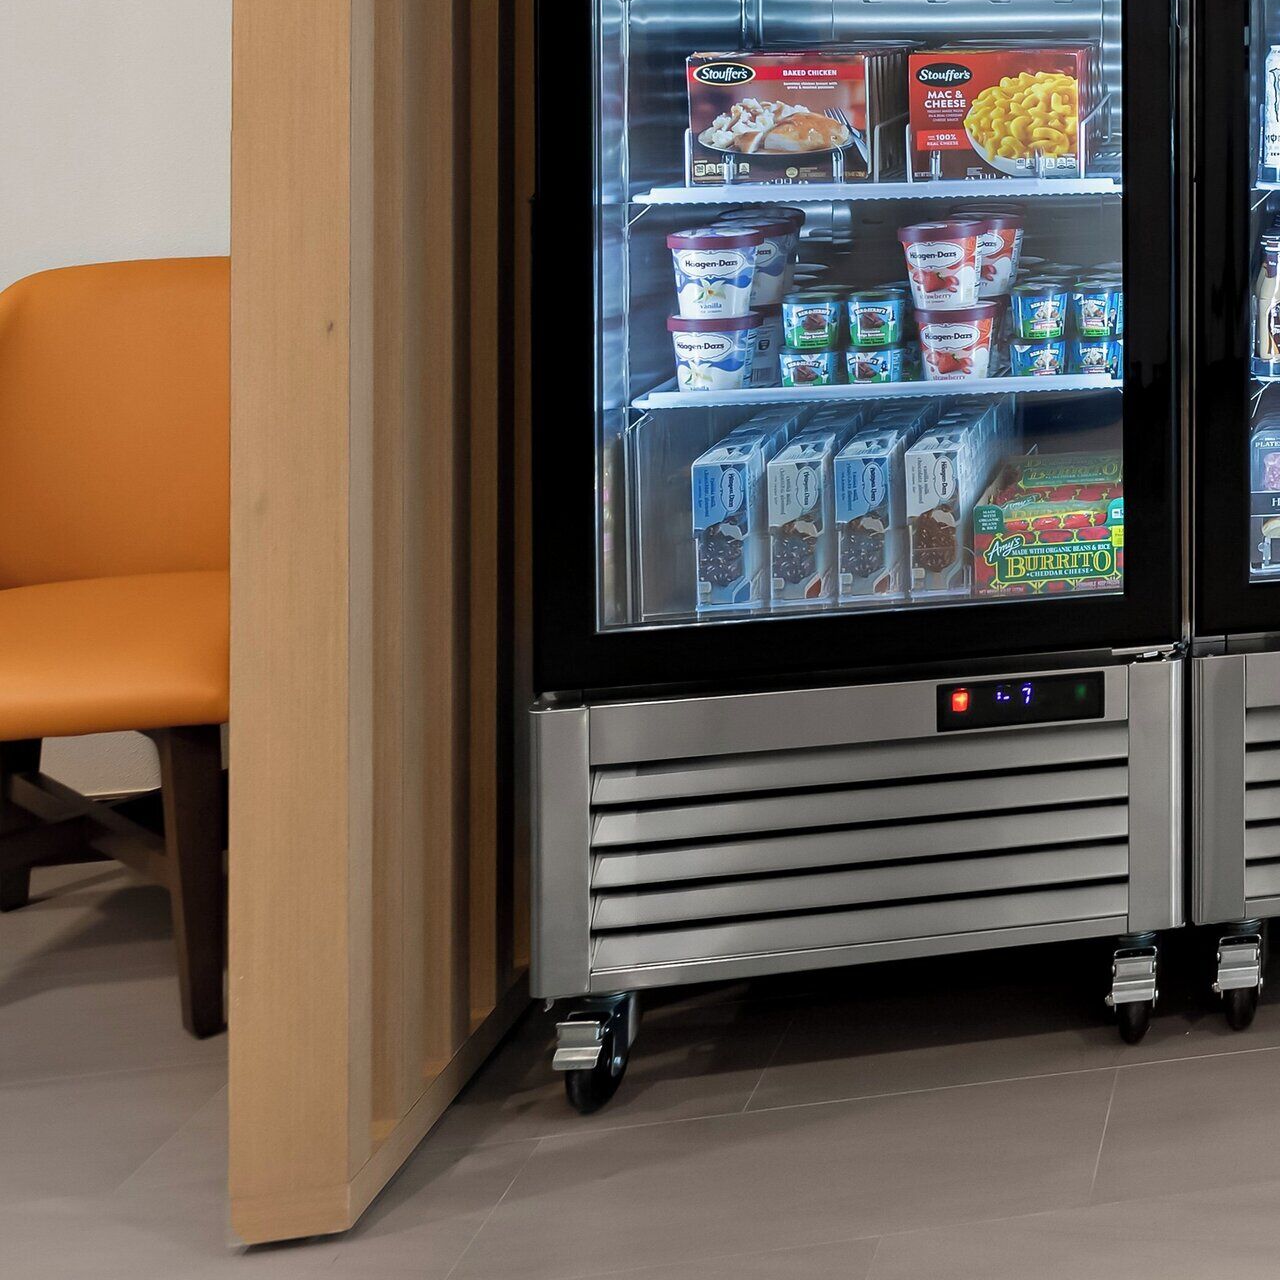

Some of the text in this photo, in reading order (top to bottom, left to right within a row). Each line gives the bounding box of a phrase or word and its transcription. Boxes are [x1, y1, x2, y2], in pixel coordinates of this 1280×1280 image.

[701, 67, 748, 82] Stouffer's
[918, 68, 971, 82] Stouffer's
[927, 90, 963, 99] MAC &
[924, 99, 966, 108] CHEESE
[935, 133, 957, 141] 100%
[987, 537, 1021, 562] Amy's
[1044, 546, 1072, 554] ORGANIC
[1004, 549, 1111, 579] BURRITO
[1029, 567, 1091, 577] CHEDDAR CHEESE
